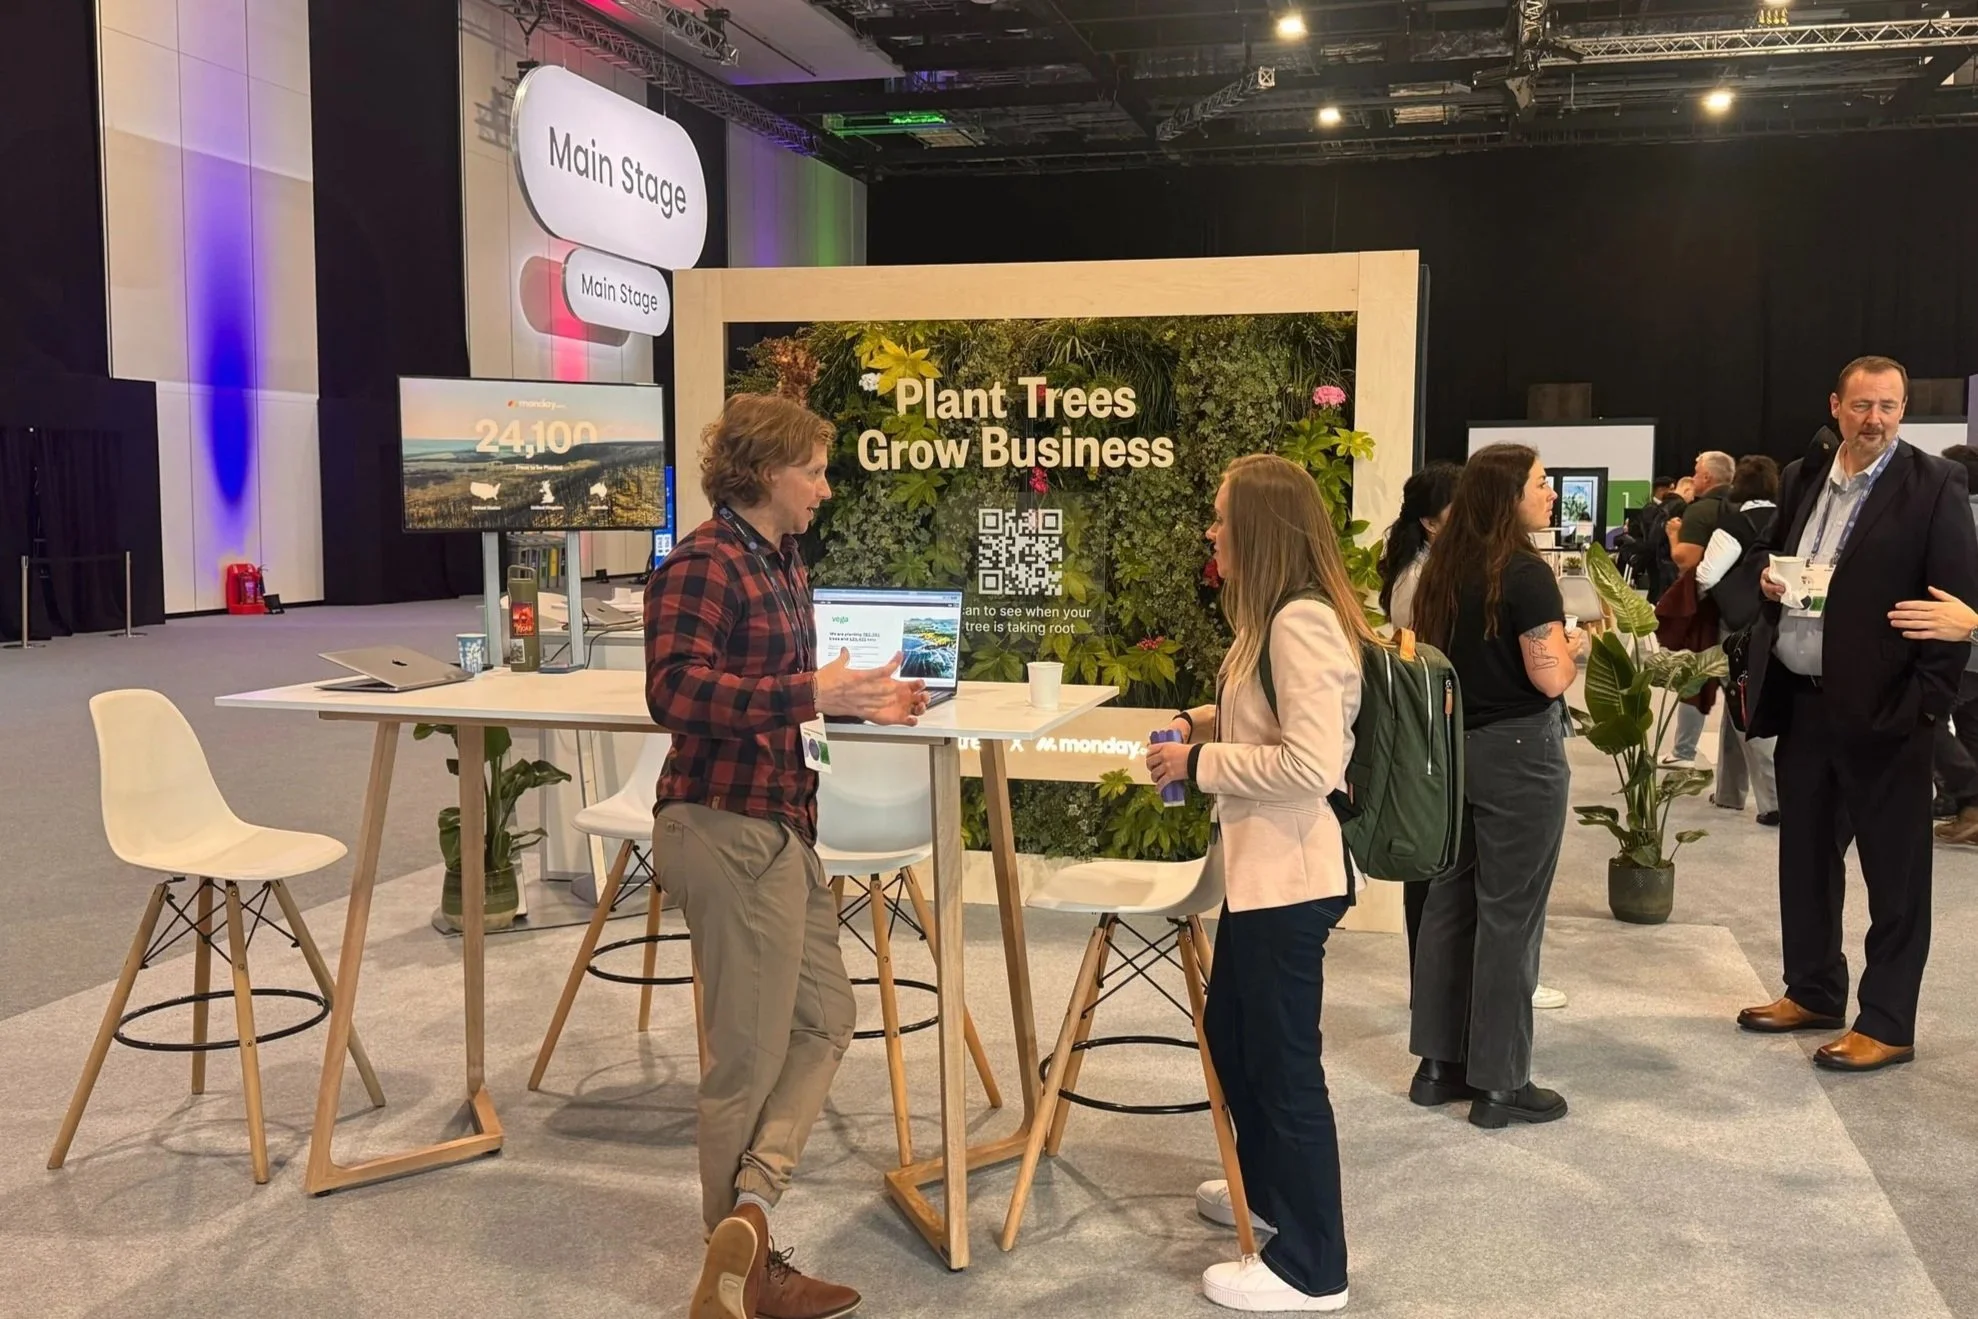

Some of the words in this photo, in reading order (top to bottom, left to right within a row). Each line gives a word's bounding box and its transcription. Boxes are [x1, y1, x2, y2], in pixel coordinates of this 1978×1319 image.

[549, 125, 613, 187] Main
[621, 156, 687, 219] Stage
[581, 273, 616, 302] Main
[619, 283, 658, 315] Stage
[896, 377, 1008, 420] Plant
[1018, 376, 1137, 419] Trees
[475, 418, 598, 459] 24,100
[857, 428, 970, 471] Grow
[981, 426, 1175, 469] Business
[965, 622, 990, 632] tree
[993, 621, 1004, 632] is
[1007, 621, 1046, 636] taking
[1049, 623, 1076, 634] root
[983, 605, 996, 617] to
[999, 606, 1022, 617] see
[1025, 605, 1059, 618] when
[1063, 608, 1092, 620] your
